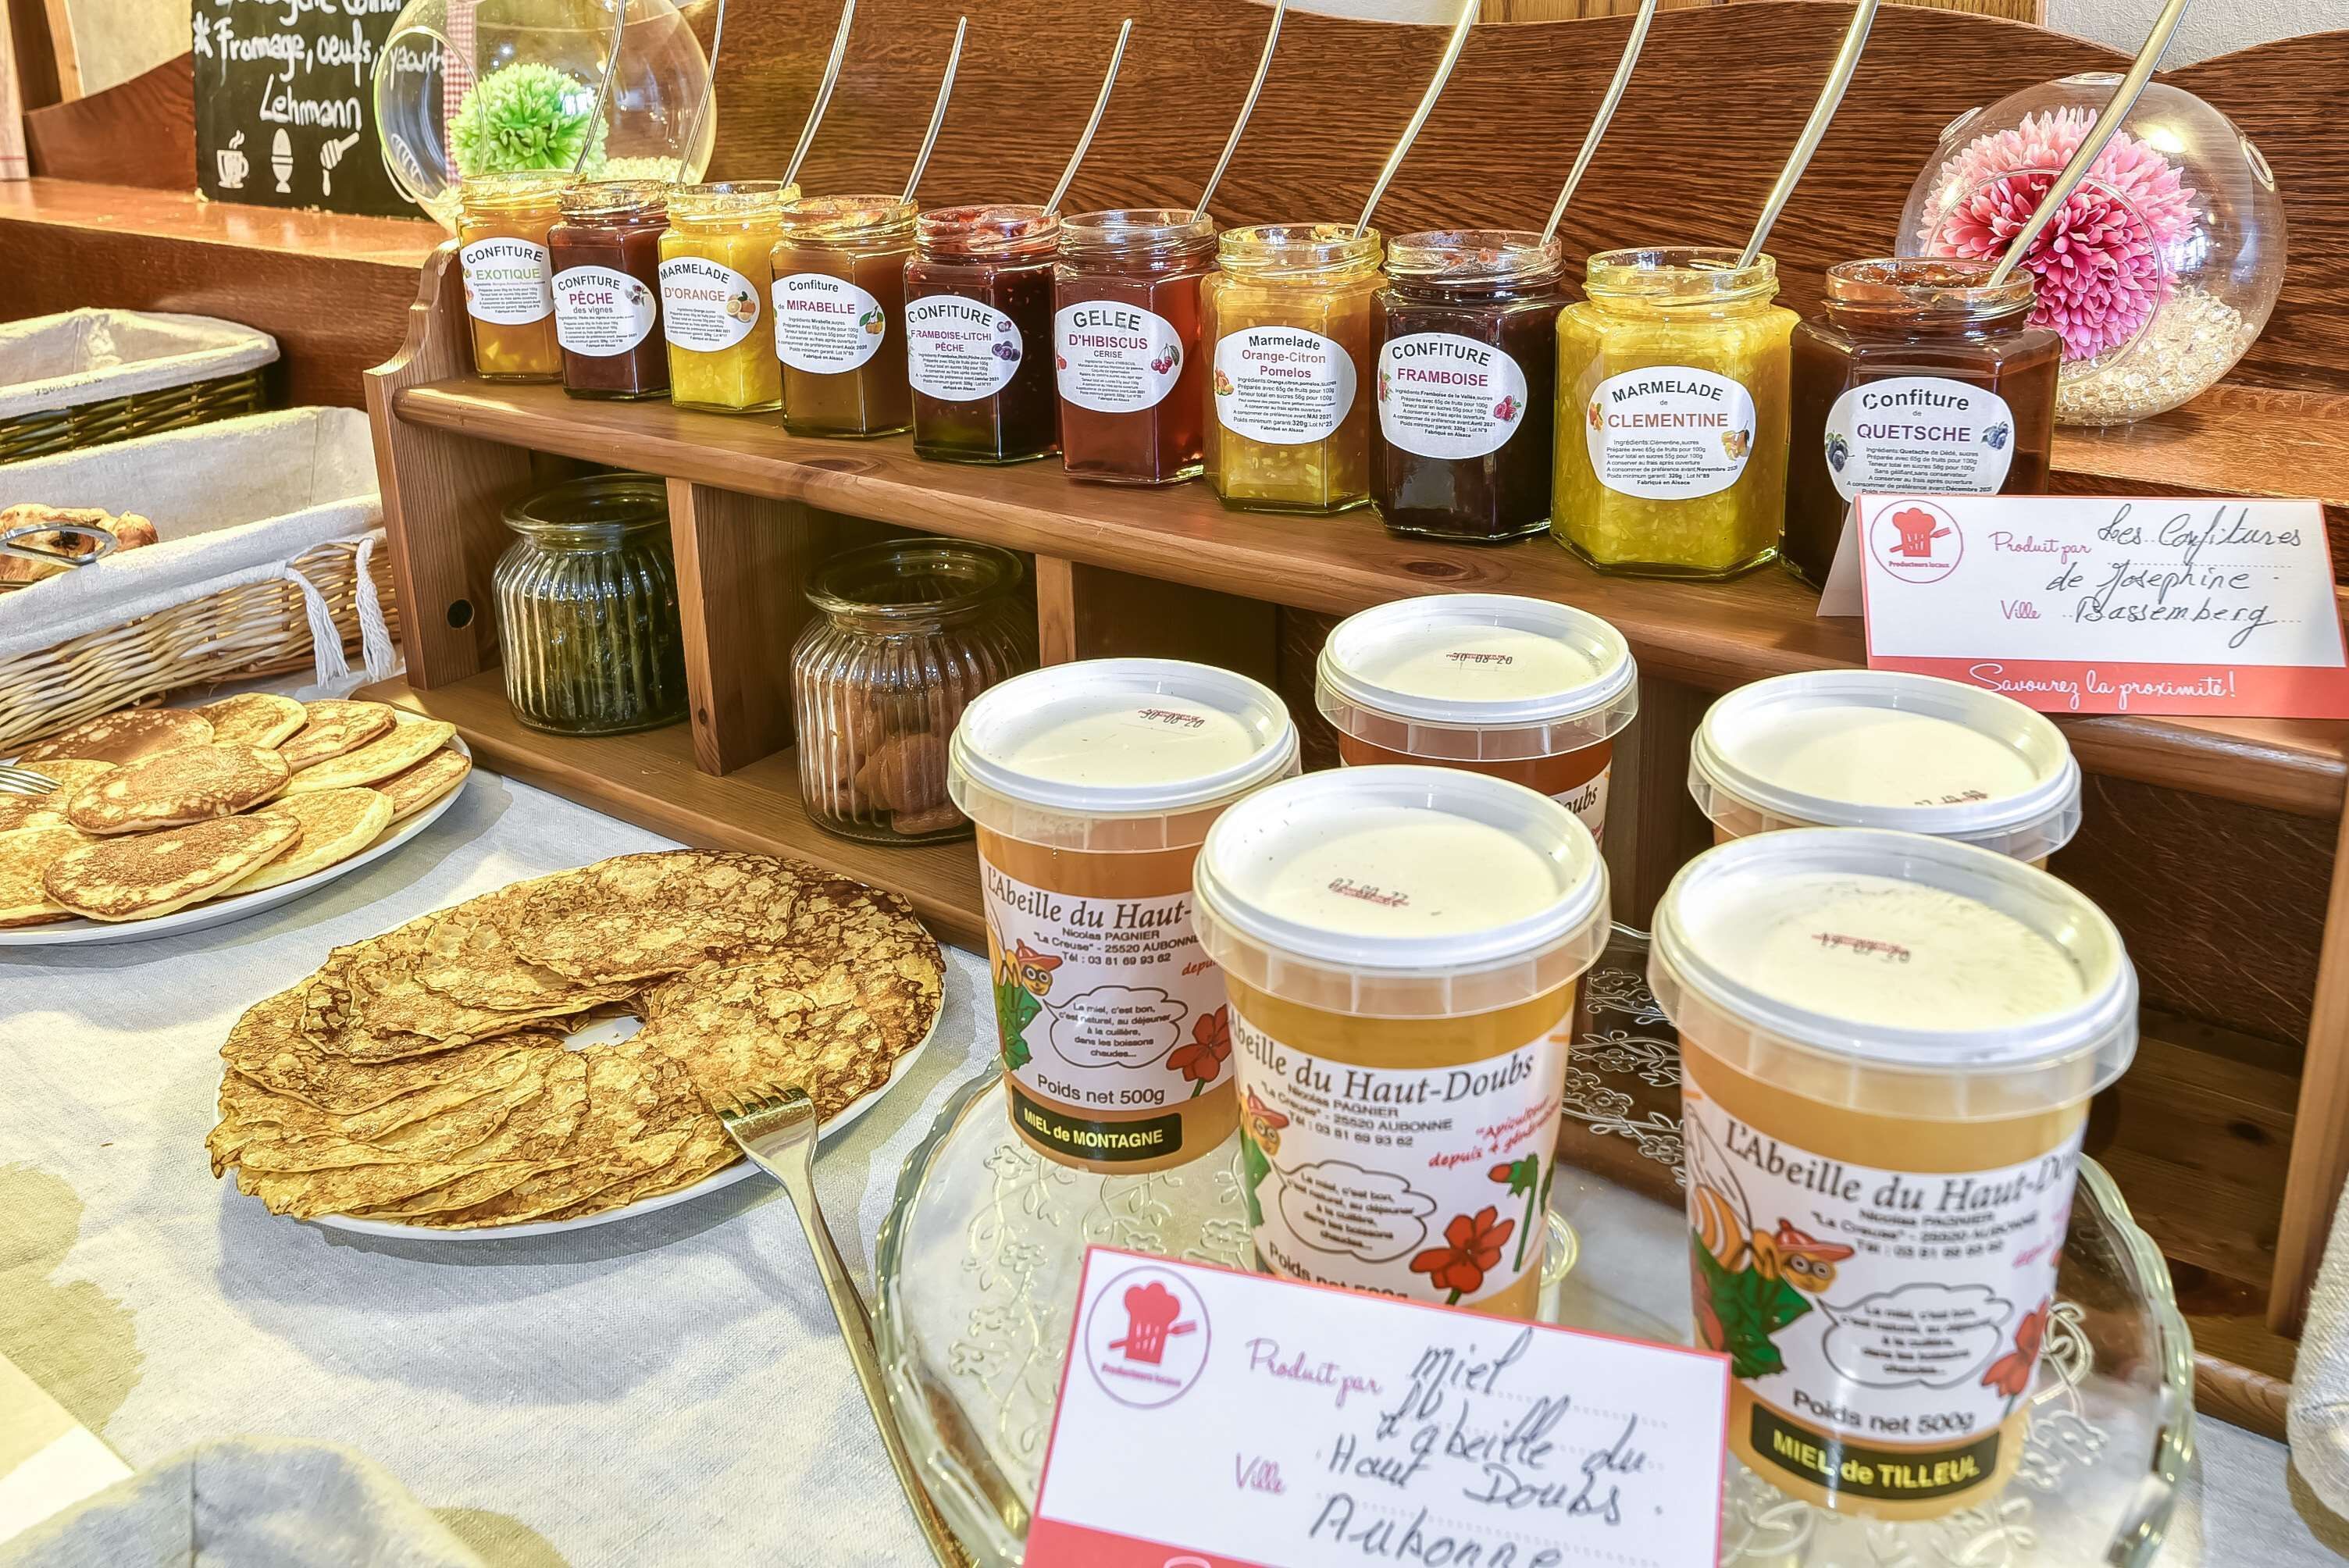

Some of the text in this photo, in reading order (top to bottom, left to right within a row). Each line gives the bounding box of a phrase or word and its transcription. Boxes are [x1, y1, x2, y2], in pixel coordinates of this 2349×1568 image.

[259, 74, 362, 131] Lehmann
[467, 246, 544, 264] CONFITURE
[476, 268, 541, 280] EXOTIQUE
[558, 276, 620, 290] CONFITURE
[661, 264, 729, 283] MARMELADE
[665, 287, 725, 302] D'ORANGE
[789, 280, 839, 292] Confiture
[569, 290, 614, 305] PÊCHE
[787, 300, 855, 314] MIRABELLE
[588, 307, 613, 315] vignes
[908, 305, 992, 327] CONFITURE
[1073, 310, 1141, 331] GELEE
[911, 330, 992, 340] FRAMBOISE-LITCHI
[1069, 334, 1148, 349] D'HIBISCUS
[1249, 336, 1320, 350] Marmelade
[936, 343, 964, 352] PÊCHE
[1242, 350, 1326, 364] Orange-Citron
[1392, 342, 1491, 366] CONFITURE
[1260, 365, 1311, 378] Pomelos
[1398, 368, 1488, 387] FRAMBOISE
[1612, 381, 1723, 403] MARMELADE
[1862, 389, 1969, 410] Confiture
[1608, 413, 1728, 428] CLEMENTINE
[1857, 424, 1971, 442] QUETSCHE
[1989, 531, 2091, 565] Produit par
[2001, 600, 2041, 620] Ville
[1969, 663, 2079, 710] Savourez
[2086, 670, 2116, 697] la
[1555, 783, 1598, 814] oubs
[987, 868, 1062, 921] L'Abeille
[1070, 900, 1104, 928] du
[1034, 931, 1050, 944] "La
[1052, 937, 1093, 951] Creuse"
[1105, 944, 1139, 953] 25520
[1062, 928, 1160, 941] Nicolas PAGNIER
[1062, 952, 1171, 965] Tél 03 81 69 93 62
[1182, 960, 1216, 976] depu
[1296, 1057, 1332, 1094] du
[1345, 1052, 1535, 1104] Haut-Doubs
[1038, 1074, 1165, 1105] Poids net 500g
[1334, 1101, 1399, 1117] PAGNIER
[1024, 1107, 1163, 1149] MIEL de MONTAGNE
[1724, 1120, 1862, 1203] L'Abeille
[1873, 1177, 1923, 1211] du
[1270, 1241, 1310, 1282] Poids
[1246, 1338, 1382, 1406] Produit par
[1793, 1388, 1976, 1435] Poids net 500g
[1773, 1429, 1980, 1489] MIEL de TILLEUL
[1235, 1452, 1287, 1496] Ville
